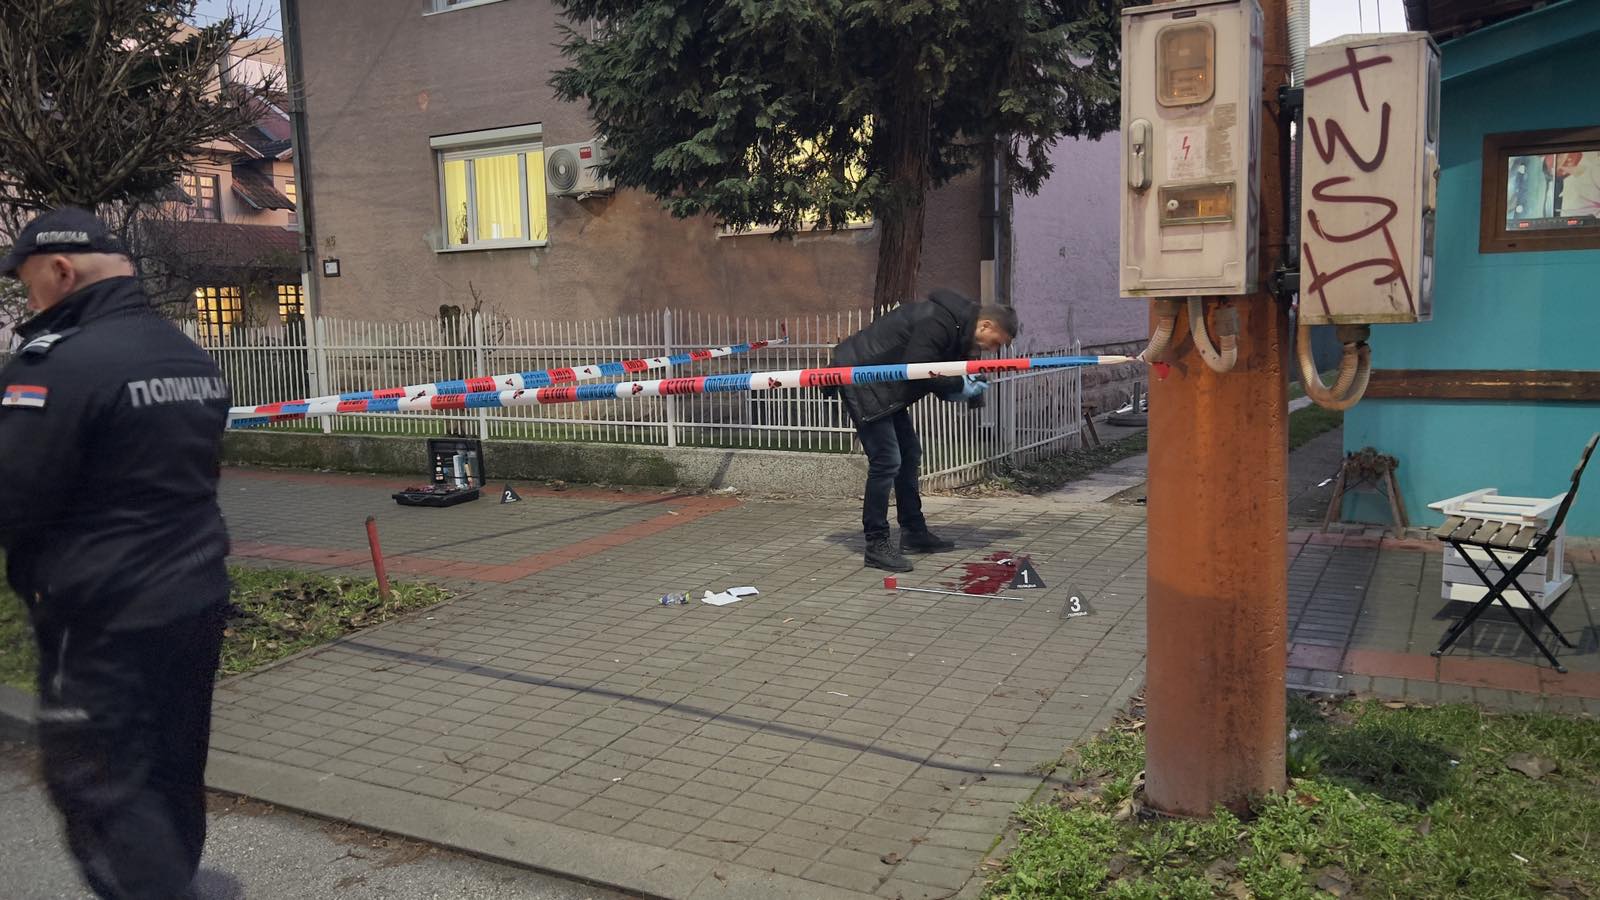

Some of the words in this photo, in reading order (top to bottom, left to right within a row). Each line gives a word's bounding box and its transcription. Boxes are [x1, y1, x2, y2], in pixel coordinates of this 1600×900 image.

[666, 379, 696, 395] СТОП
[505, 491, 513, 500] 2
[1021, 569, 1029, 584] 1
[1069, 596, 1081, 612] 3
